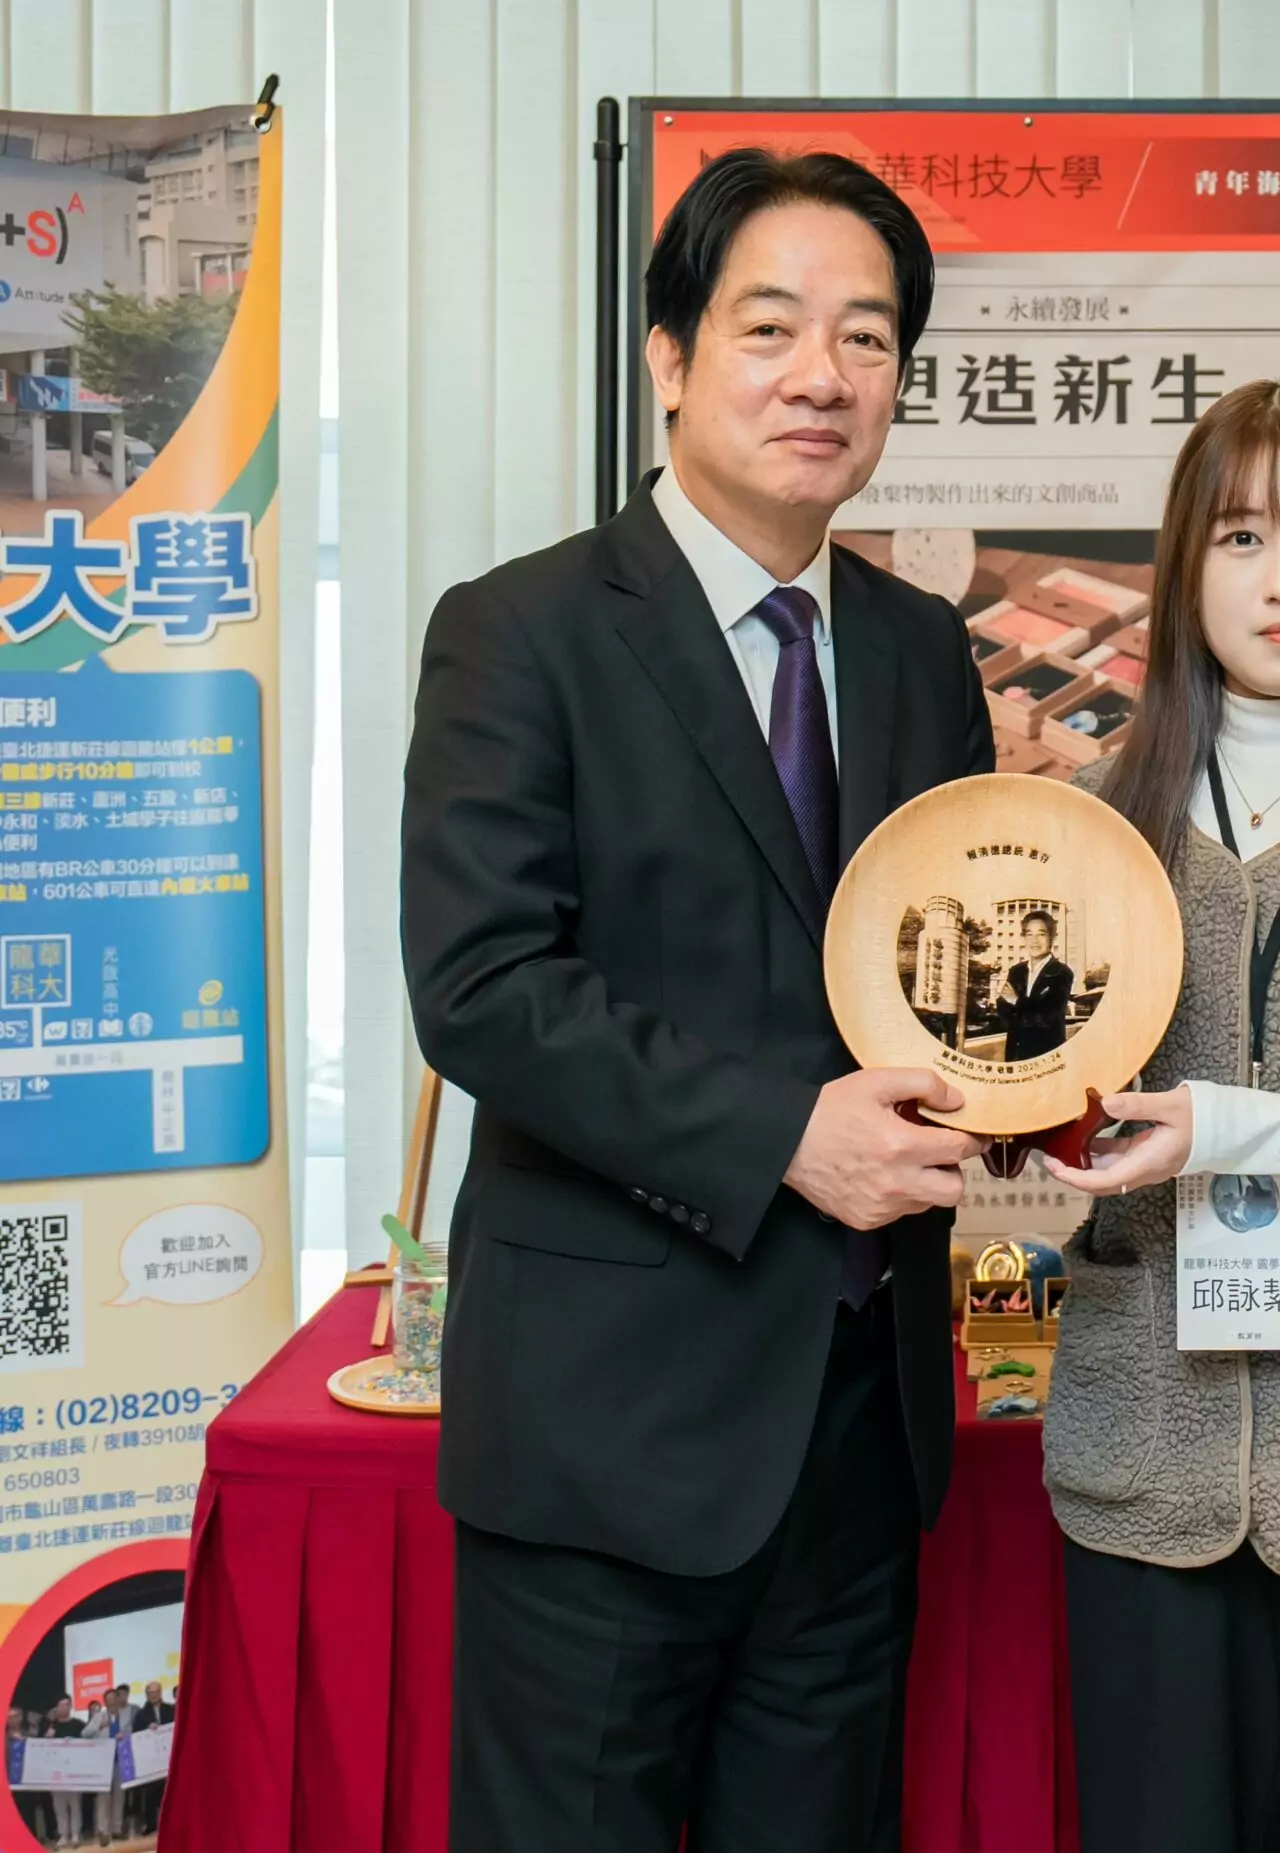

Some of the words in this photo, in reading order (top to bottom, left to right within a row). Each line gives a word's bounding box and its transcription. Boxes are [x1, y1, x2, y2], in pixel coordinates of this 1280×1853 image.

[849, 153, 1103, 200] 華科技大學
[1006, 296, 1109, 322] 永續發展
[849, 482, 1119, 505] 廢棄物製作出來的文創商品
[2, 514, 255, 640] 大學
[0, 833, 38, 852] 便利
[160, 1234, 231, 1254] 歡迎加入
[1184, 1258, 1253, 1271] 龍華科技大學
[4, 1467, 80, 1491] 650803
[0, 1483, 197, 1523] 市龜山區萬壽路一段30
